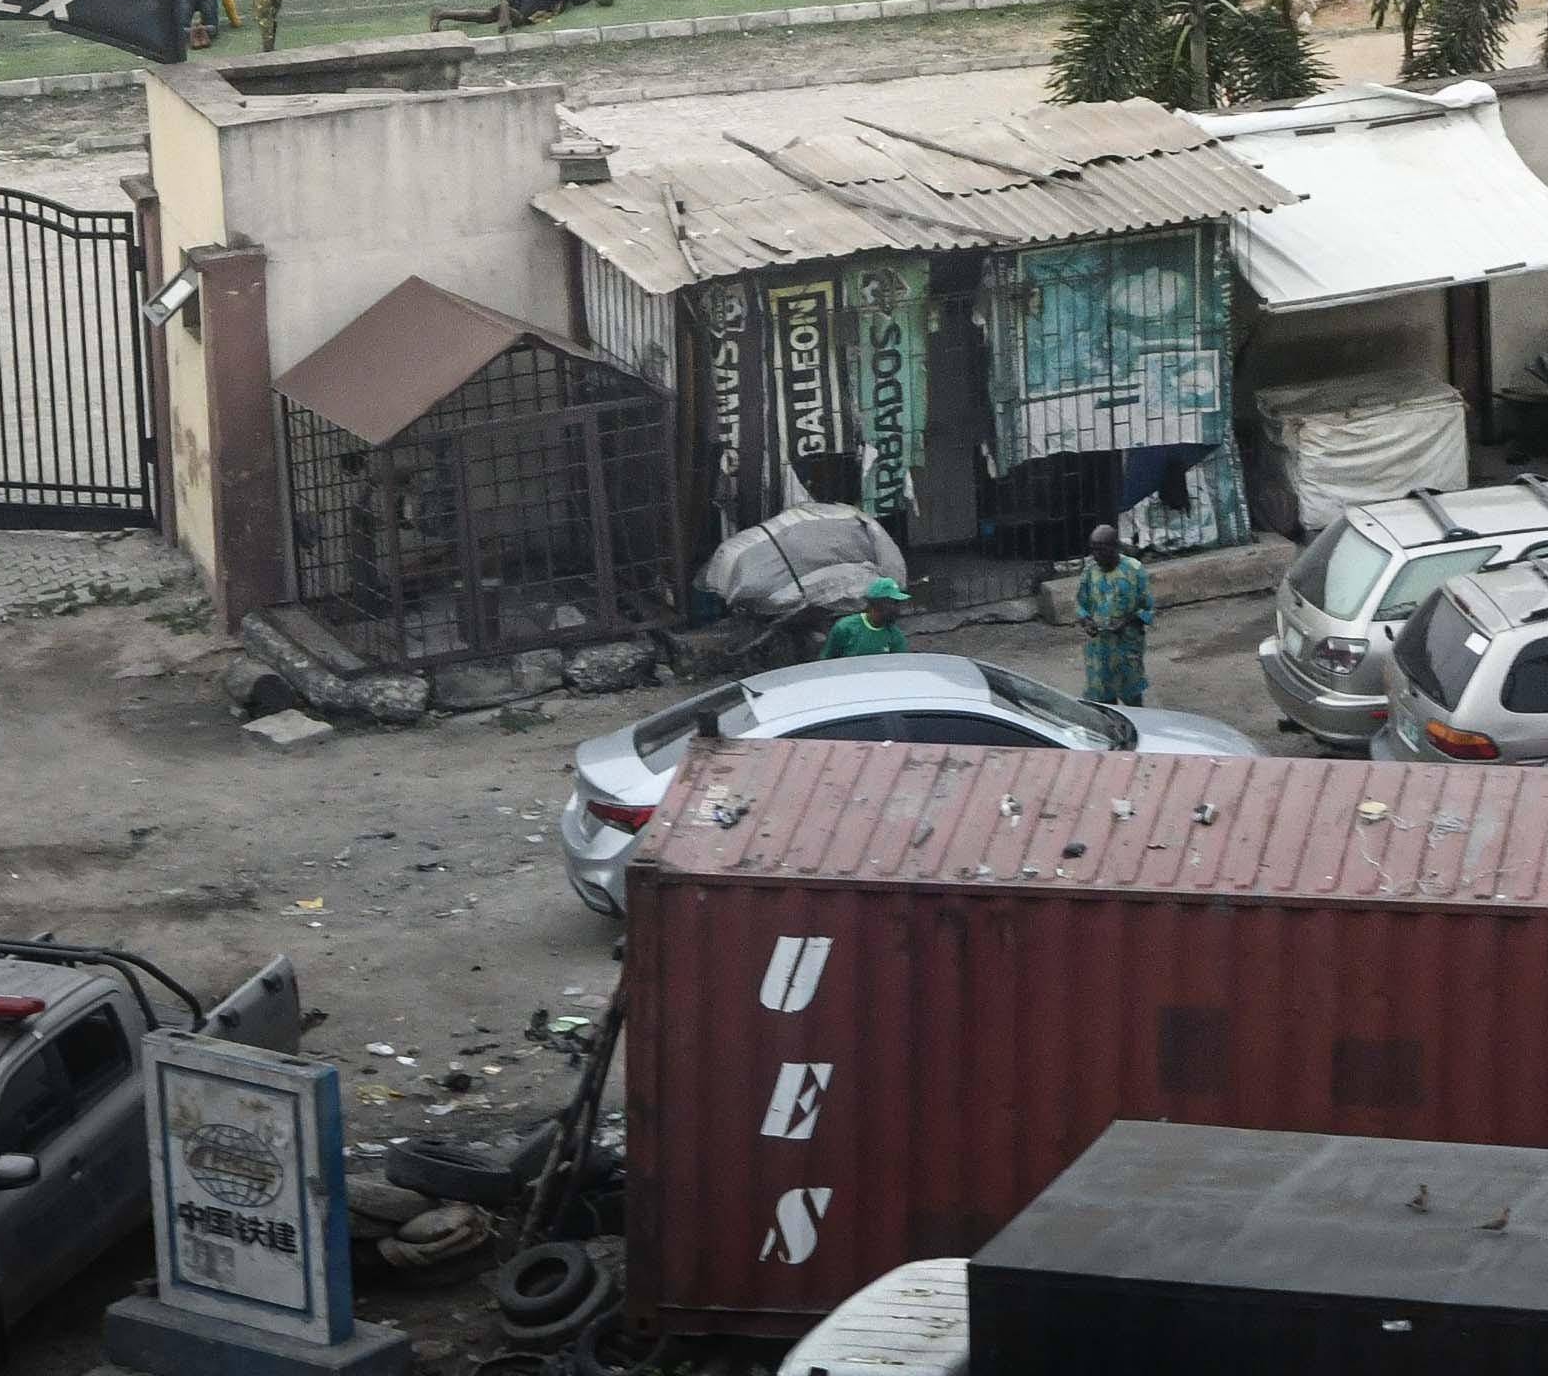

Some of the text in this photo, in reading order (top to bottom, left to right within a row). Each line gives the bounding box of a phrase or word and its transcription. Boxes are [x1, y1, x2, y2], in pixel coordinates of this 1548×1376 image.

[788, 297, 827, 458] GALLEON
[758, 936, 834, 1266] UES
[176, 1200, 298, 1254] 中国铁建
